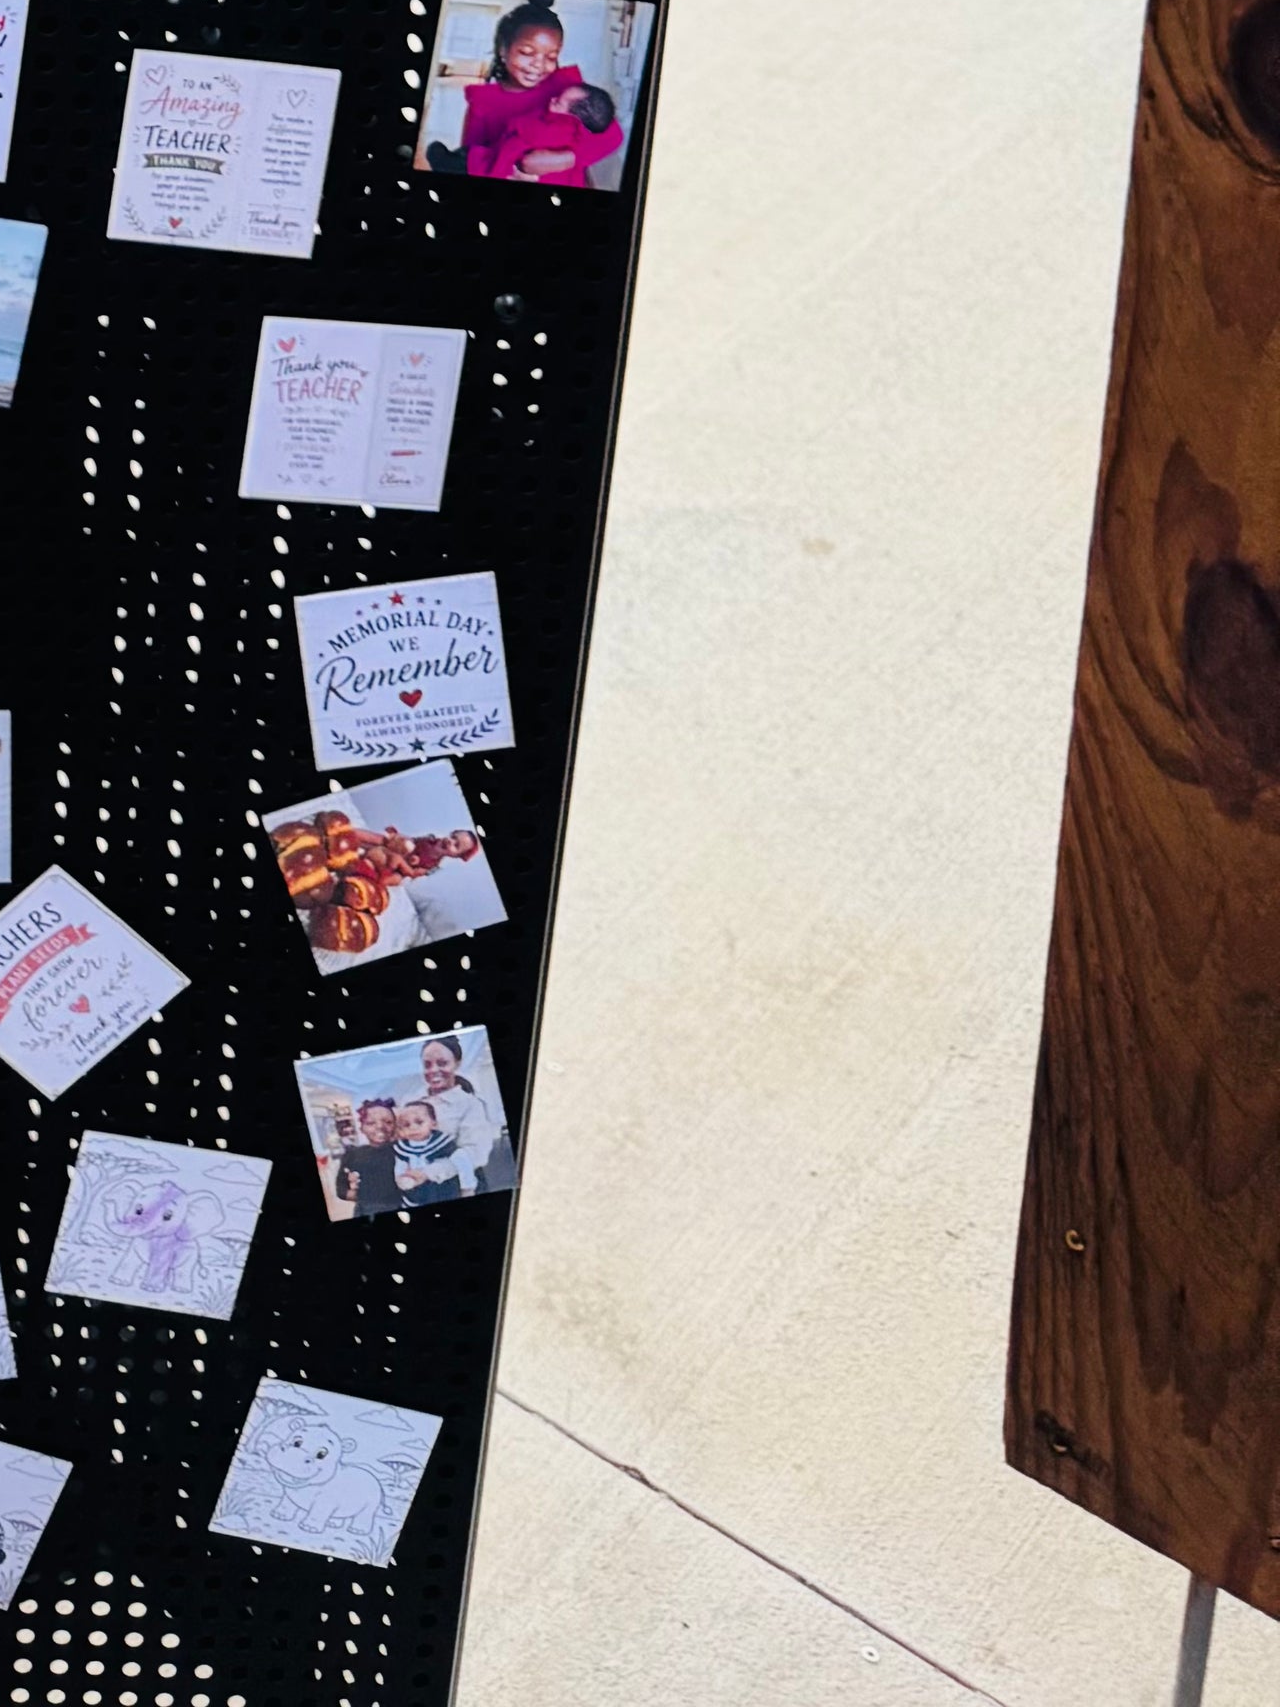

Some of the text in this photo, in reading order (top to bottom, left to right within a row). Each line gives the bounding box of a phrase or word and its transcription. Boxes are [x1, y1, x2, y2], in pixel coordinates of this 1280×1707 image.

[140, 86, 242, 130] Amazing
[143, 125, 230, 154] TEACHER
[272, 354, 321, 377] Thank
[273, 376, 363, 405] TEACHER
[328, 610, 488, 654] MEMORIAL DAY
[389, 636, 419, 652] WE
[316, 638, 499, 711] Remember
[356, 704, 477, 727] FOREVER GRATEFUL
[364, 717, 472, 738] ALWAYS HONORED
[31, 932, 71, 964] SEEDS
[21, 957, 104, 1033] forever
